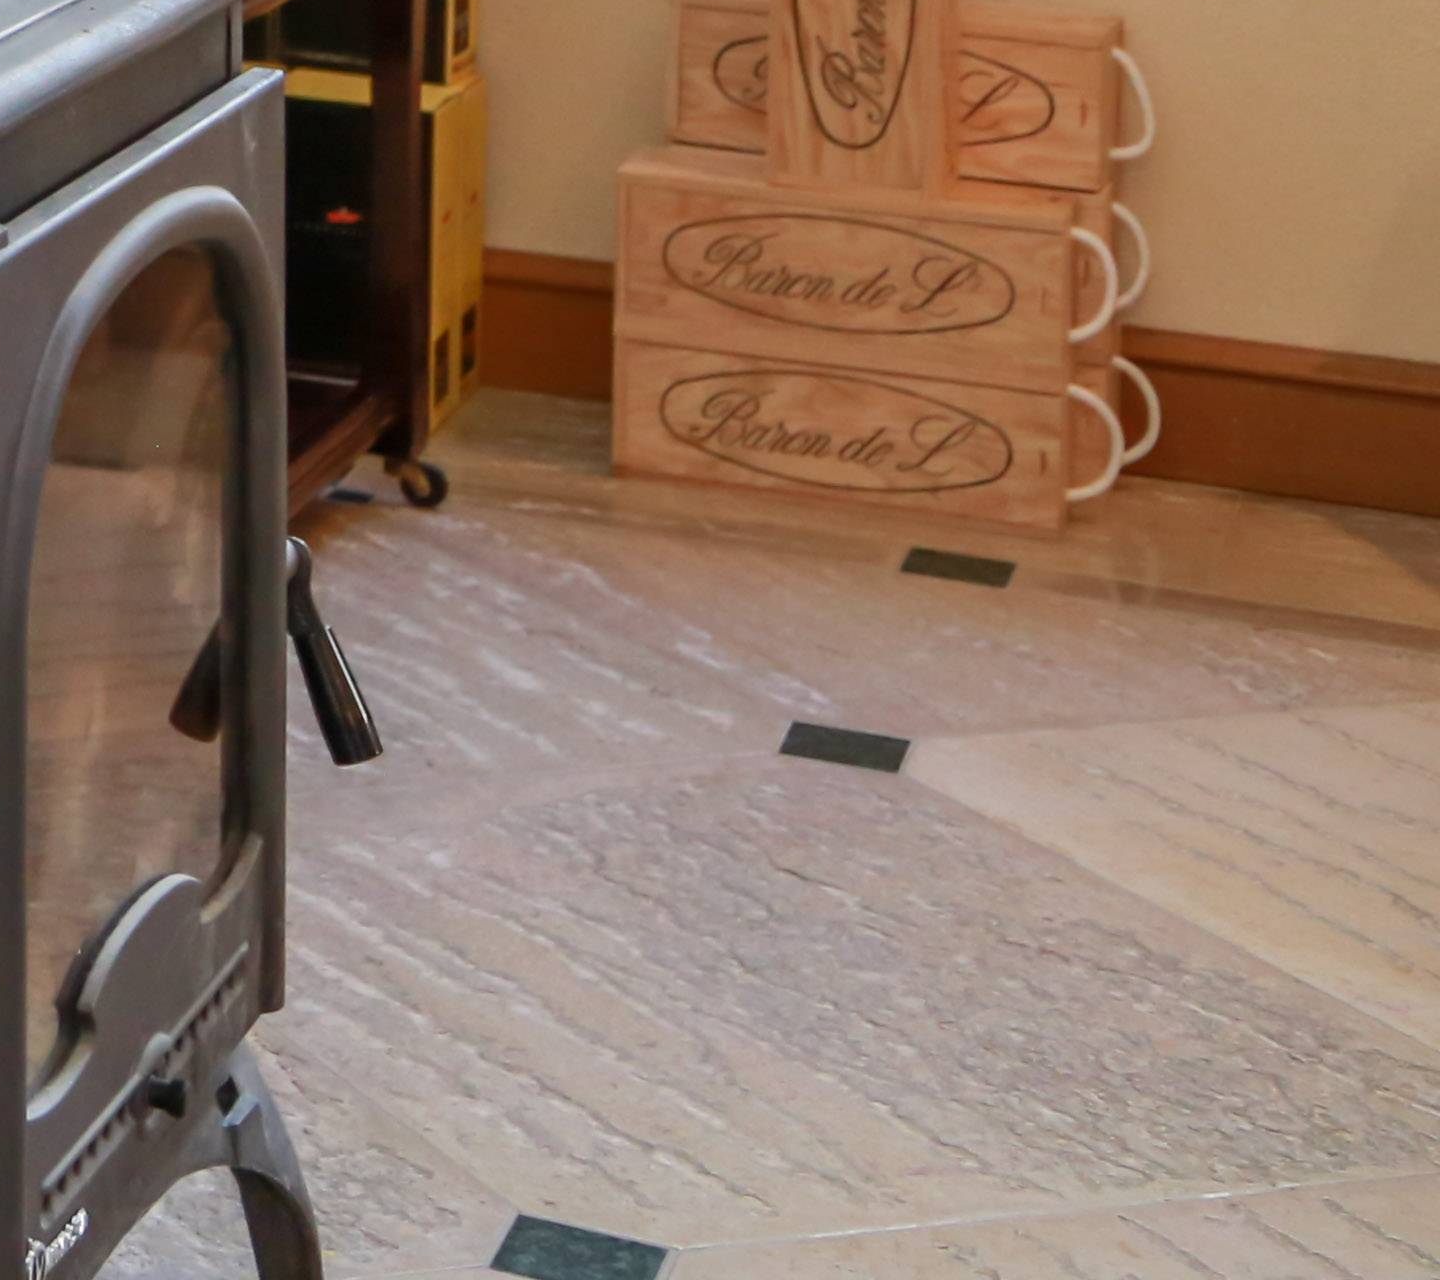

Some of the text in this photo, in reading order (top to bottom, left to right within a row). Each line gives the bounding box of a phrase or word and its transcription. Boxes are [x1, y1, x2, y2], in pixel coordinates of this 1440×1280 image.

[692, 233, 981, 318] Baron de L
[688, 389, 979, 478] Baron de L
